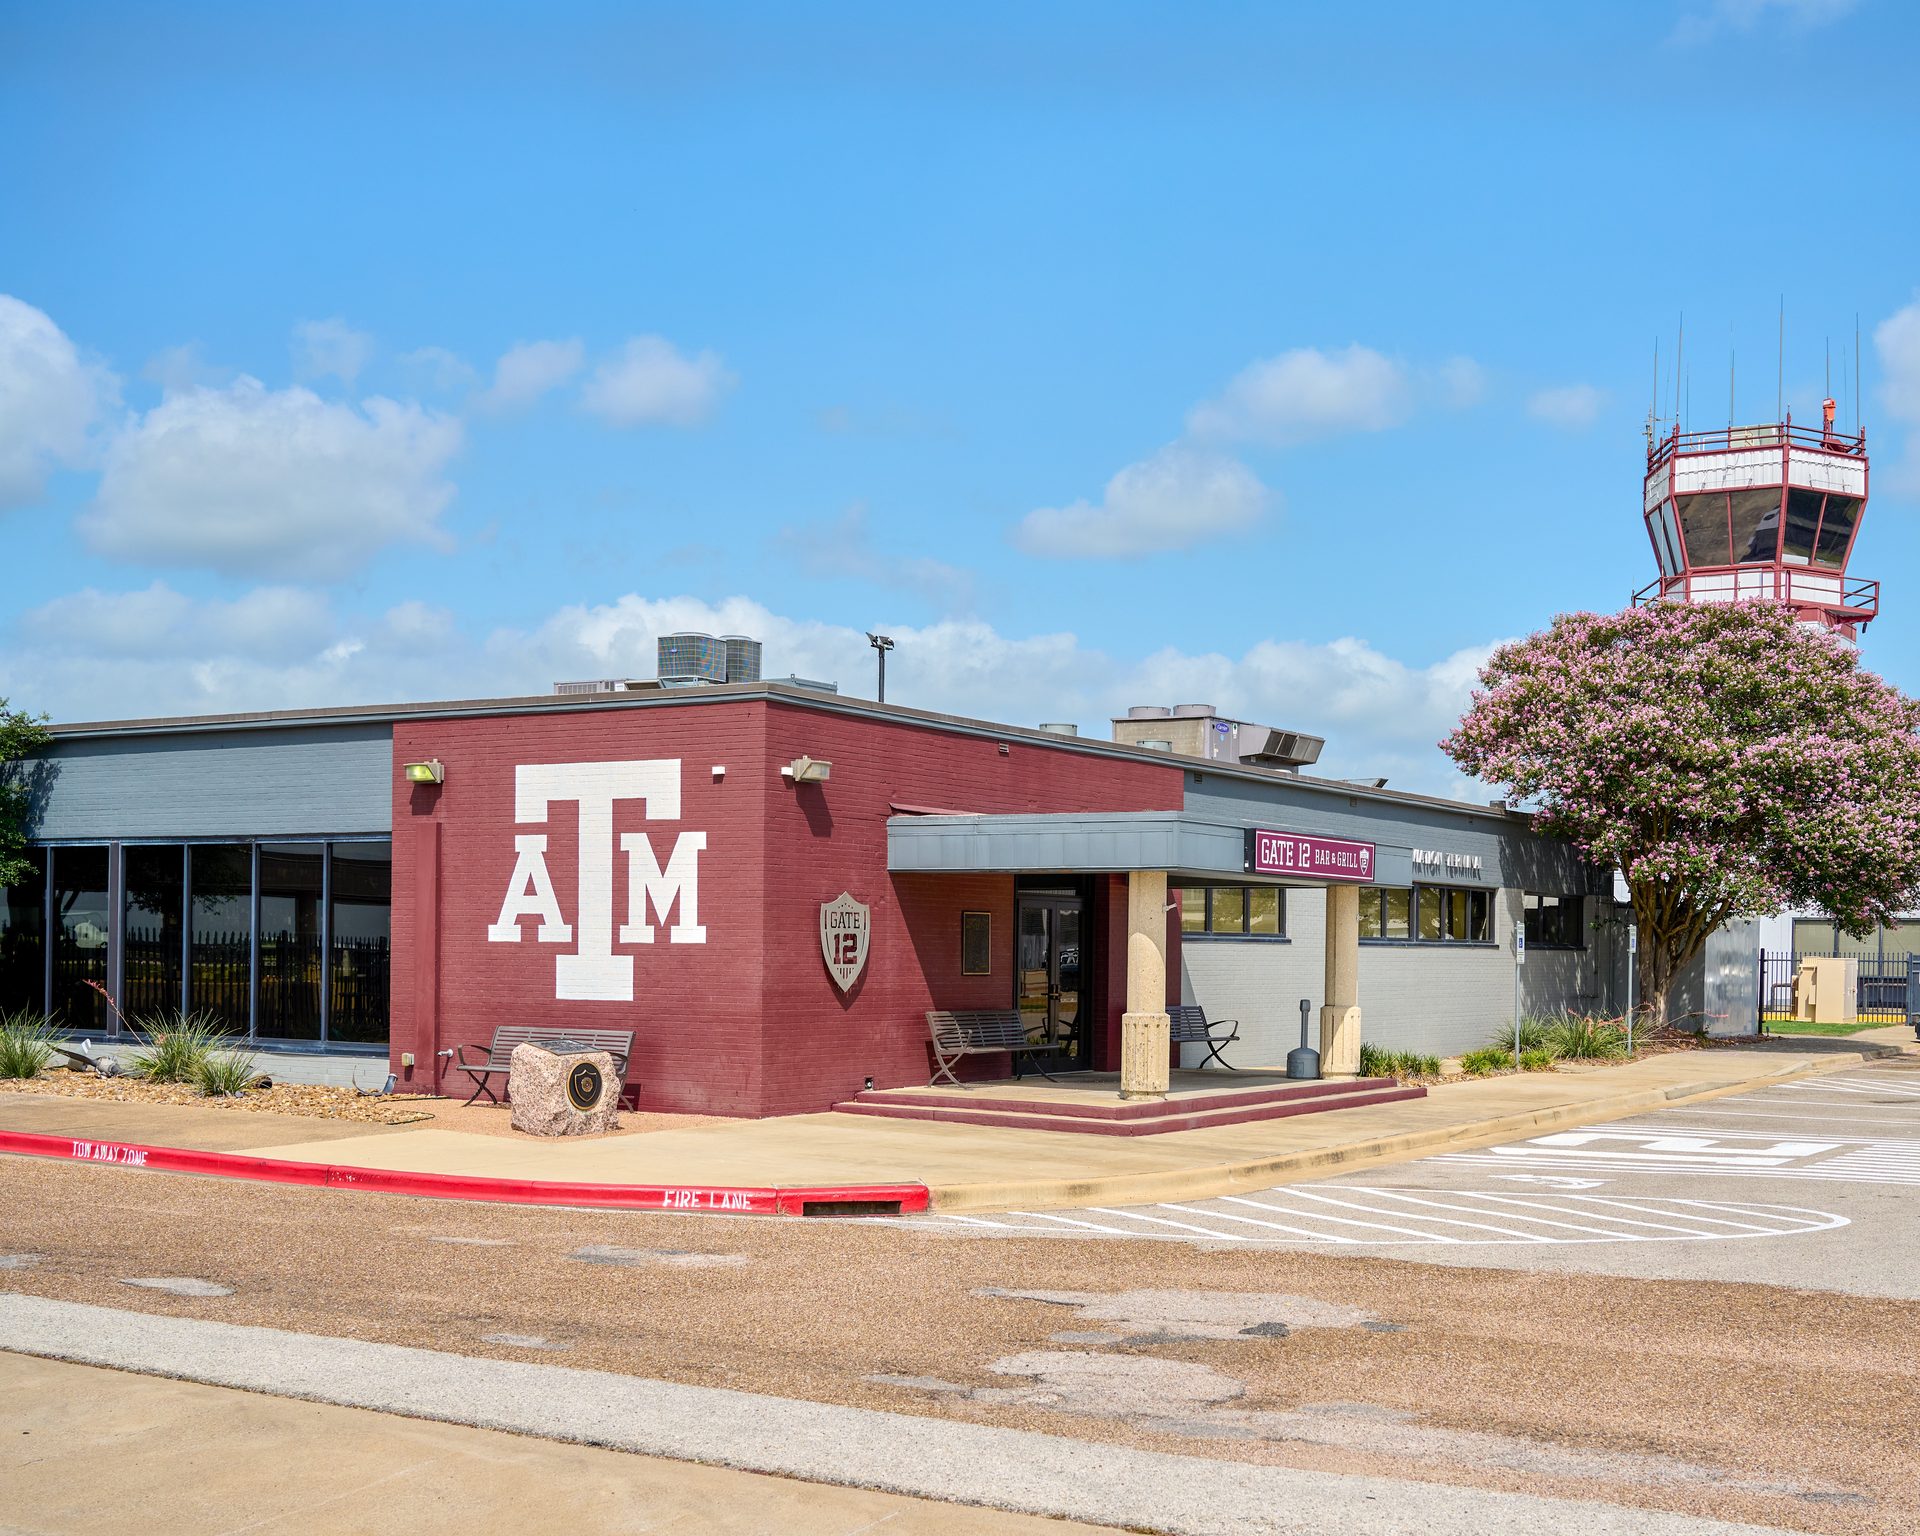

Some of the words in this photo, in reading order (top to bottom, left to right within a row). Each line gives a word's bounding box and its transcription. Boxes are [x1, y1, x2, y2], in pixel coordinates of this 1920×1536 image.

[1261, 838, 1294, 866] GATE
[1298, 842, 1311, 868] 12
[1315, 849, 1330, 866] BAR
[1331, 852, 1336, 864] &
[1337, 852, 1357, 868] GRILL
[830, 911, 861, 929] GATE
[833, 933, 858, 965] 12
[72, 1141, 92, 1158] TOW
[93, 1144, 119, 1162] AWAY
[120, 1147, 149, 1166] ZONE
[662, 1190, 702, 1208] FIRE
[709, 1191, 753, 1211] LANE
